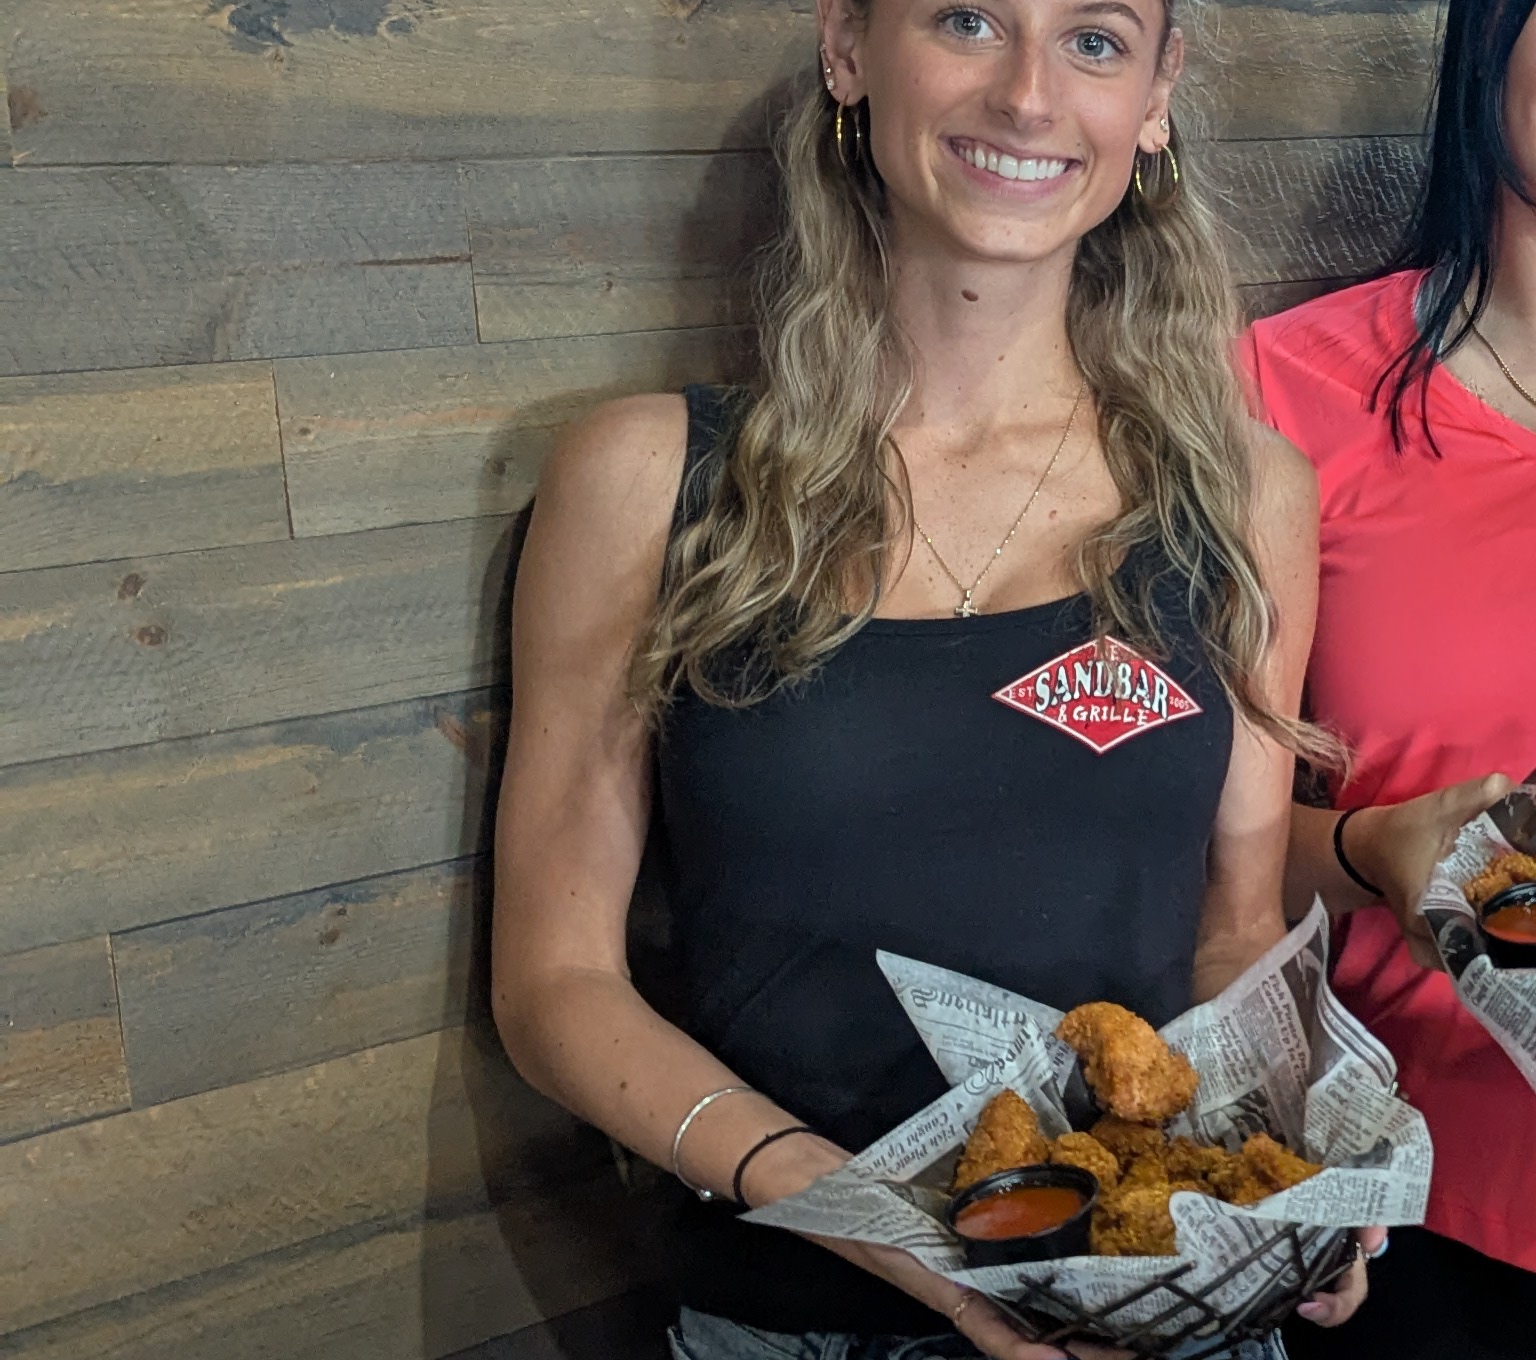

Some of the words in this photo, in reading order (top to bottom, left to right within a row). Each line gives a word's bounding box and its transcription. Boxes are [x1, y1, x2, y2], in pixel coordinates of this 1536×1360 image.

[1009, 685, 1035, 700] EST
[1035, 660, 1169, 720] SANDBAR
[1057, 705, 1068, 723] &
[1072, 705, 1149, 727] GRILLE
